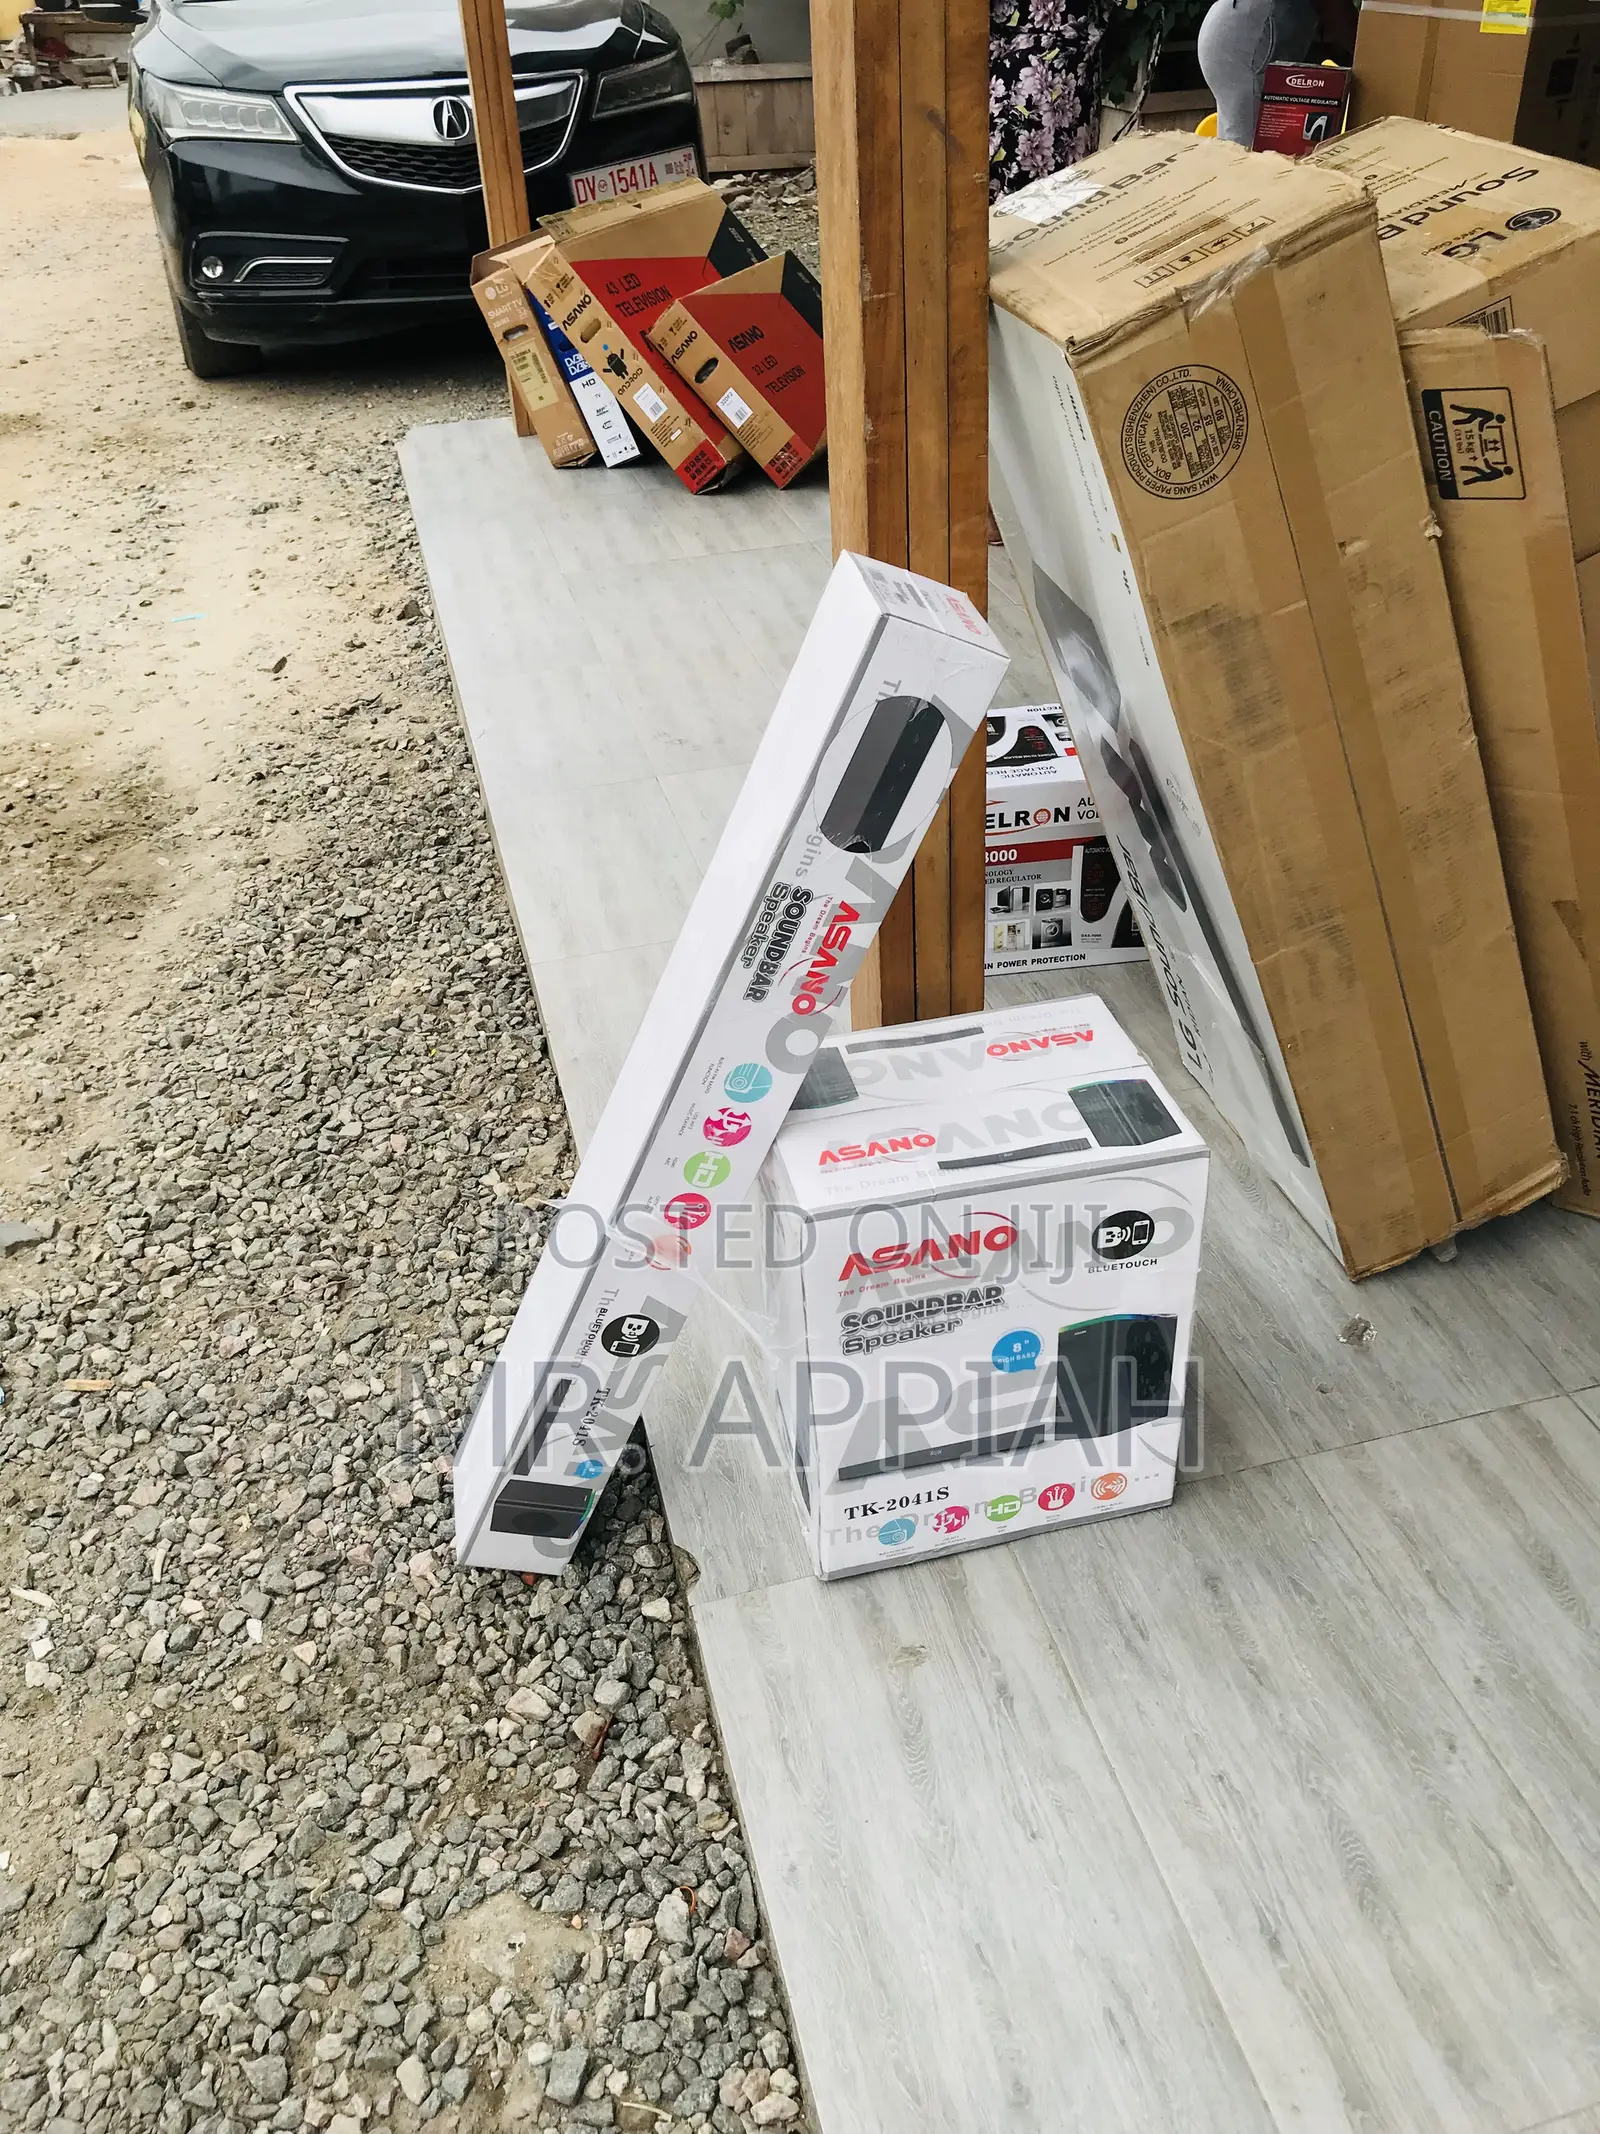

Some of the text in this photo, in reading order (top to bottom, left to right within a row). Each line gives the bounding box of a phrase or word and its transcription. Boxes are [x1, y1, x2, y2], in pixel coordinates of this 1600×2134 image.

[1287, 75, 1325, 88] DELRON
[1264, 95, 1289, 103] AUTOMATIC
[1311, 98, 1339, 107] REGULATOR
[573, 162, 659, 205] DV 1541A
[1110, 154, 1180, 190] Bar
[1378, 178, 1470, 223] MERIDIAN
[1400, 165, 1541, 227] Sound
[1036, 191, 1129, 241] MERIDIAN
[1440, 229, 1509, 260] LG
[495, 283, 509, 295] LG
[605, 272, 642, 296] 43 LED
[487, 299, 524, 320] SMART TV
[562, 294, 592, 331] ASANO
[616, 285, 673, 318] TELEVISION
[670, 330, 698, 365] ASANO
[727, 324, 765, 354] ASANO
[751, 354, 779, 376] 32 LED
[581, 378, 597, 389] HD
[617, 367, 643, 396] ANDROID
[764, 364, 806, 396] TELEVISION
[1215, 375, 1237, 400] CHINA
[1197, 387, 1206, 408] INCHES
[1192, 420, 1202, 432] 92
[1203, 414, 1213, 427] 85
[1214, 409, 1225, 421] 80
[1153, 425, 1168, 464] DOUBLEWALL
[1180, 423, 1192, 440] 200
[1464, 429, 1475, 453] 15 kg
[1138, 411, 1172, 481] BOX CERTIFICATE
[1149, 440, 1157, 454] THIS
[1427, 409, 1452, 483] CAUTION
[1455, 441, 1463, 454] lbs)
[1144, 476, 1172, 495] PAPER
[1173, 481, 1198, 495] SANG
[1199, 472, 1219, 490] WAH
[945, 594, 980, 637] ASANO
[999, 769, 1057, 778] AUTOMATIC
[1008, 765, 1055, 773] VOLTAGE
[998, 873, 1041, 883] REGULATOR
[822, 894, 833, 909] The
[741, 881, 789, 970] Speaker
[811, 908, 826, 931] Dream
[741, 886, 813, 1006] SOUNDBAR
[791, 899, 860, 1017] ASANO
[1148, 908, 1183, 1005] Sound
[996, 958, 1028, 968] POWER
[1031, 953, 1086, 965] PROTECTION
[985, 1028, 1095, 1058] ASANO
[1184, 1023, 1203, 1072] LG
[1579, 1040, 1593, 1062] with
[700, 1062, 714, 1085] FUNCTION
[1571, 1125, 1582, 1142] High
[817, 1132, 937, 1167] ASANO
[1574, 1142, 1587, 1178] Resolution
[1581, 1177, 1592, 1197] Audio
[838, 1225, 1019, 1282] ASANO
[1088, 1258, 1158, 1274] BLUETOUCH
[838, 1272, 927, 1299] The Dream Begins
[840, 1284, 1006, 1336] SOUNDBAR
[579, 1305, 608, 1358] BLUETOUCH
[842, 1316, 963, 1358] Speaker
[997, 1355, 1014, 1364] RICH
[571, 1383, 610, 1450] TK-2041S
[843, 1486, 950, 1522] TK-2041S
